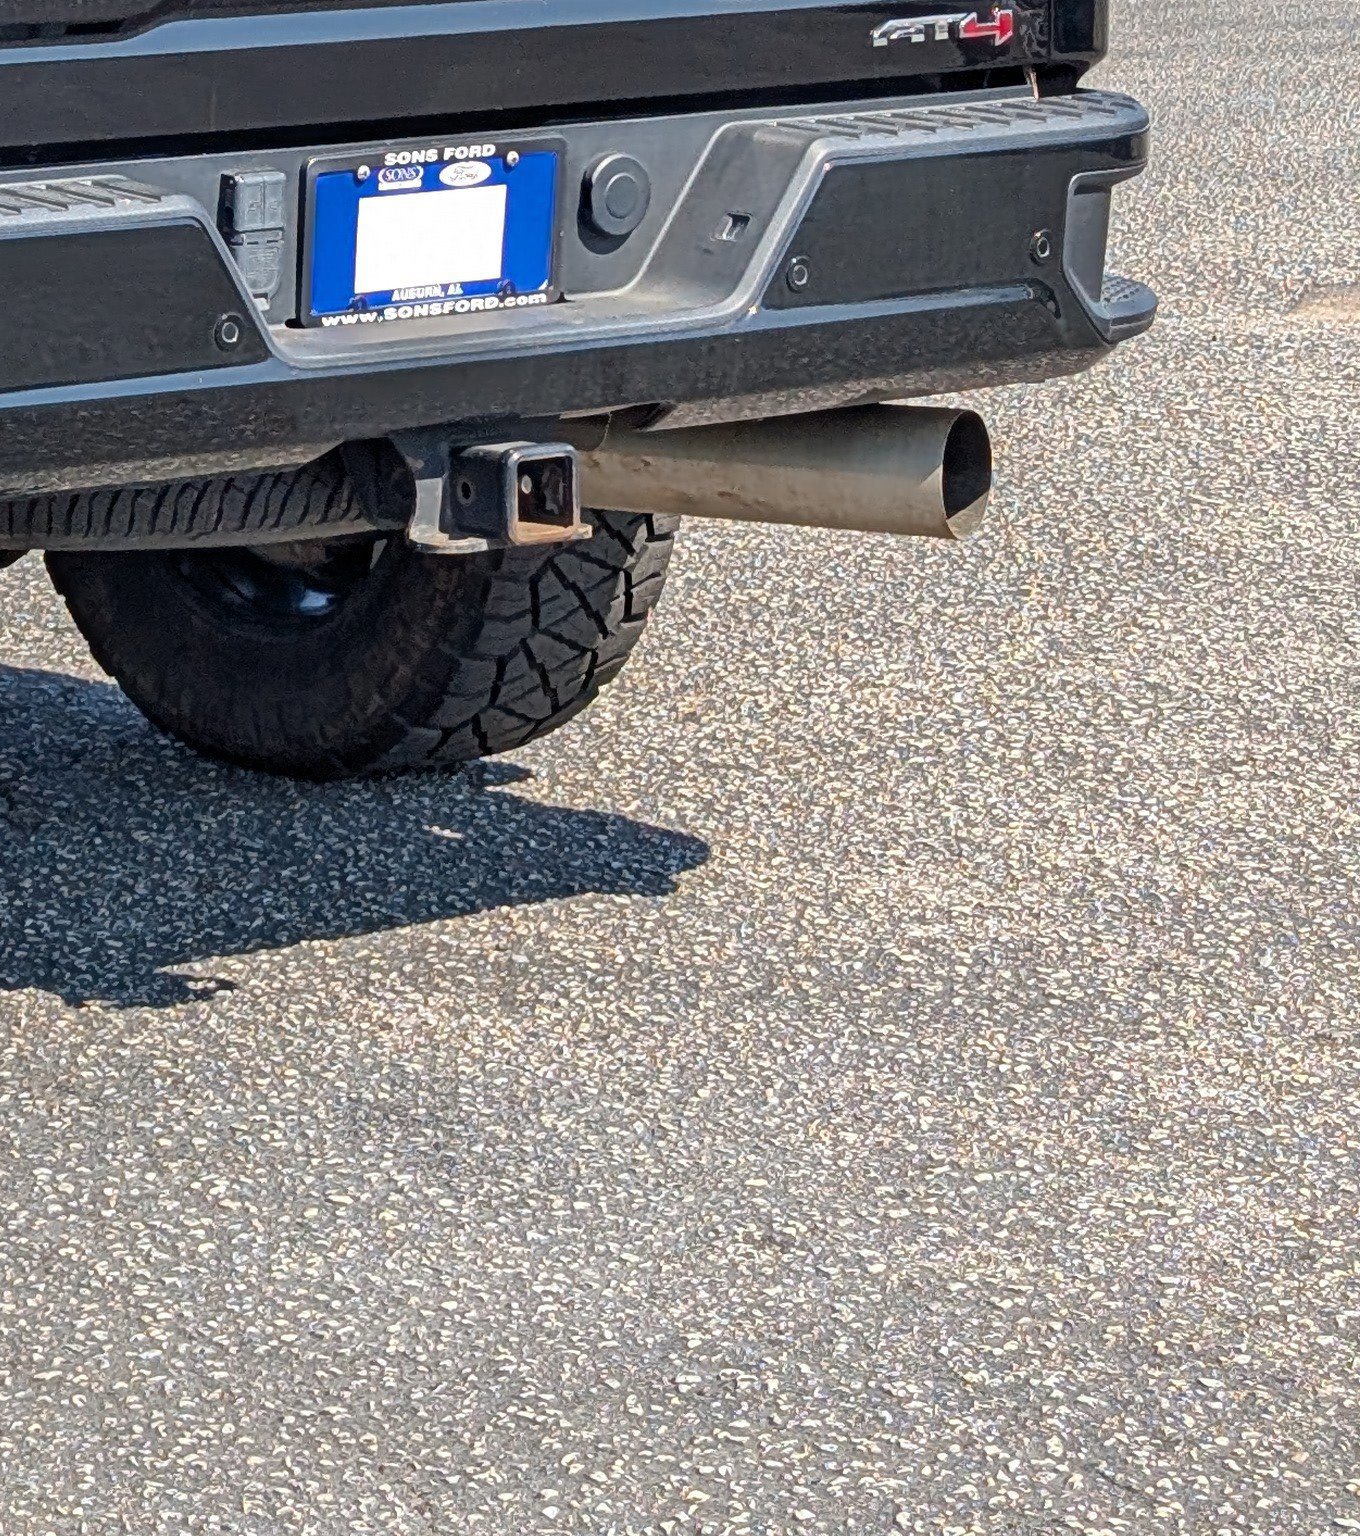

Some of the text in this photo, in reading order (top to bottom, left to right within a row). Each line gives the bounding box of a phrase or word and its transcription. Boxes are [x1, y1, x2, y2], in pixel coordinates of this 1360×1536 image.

[872, 9, 1014, 47] AT4
[384, 144, 496, 166] SONS FORD
[322, 292, 548, 327] www.SONSFORD.com
